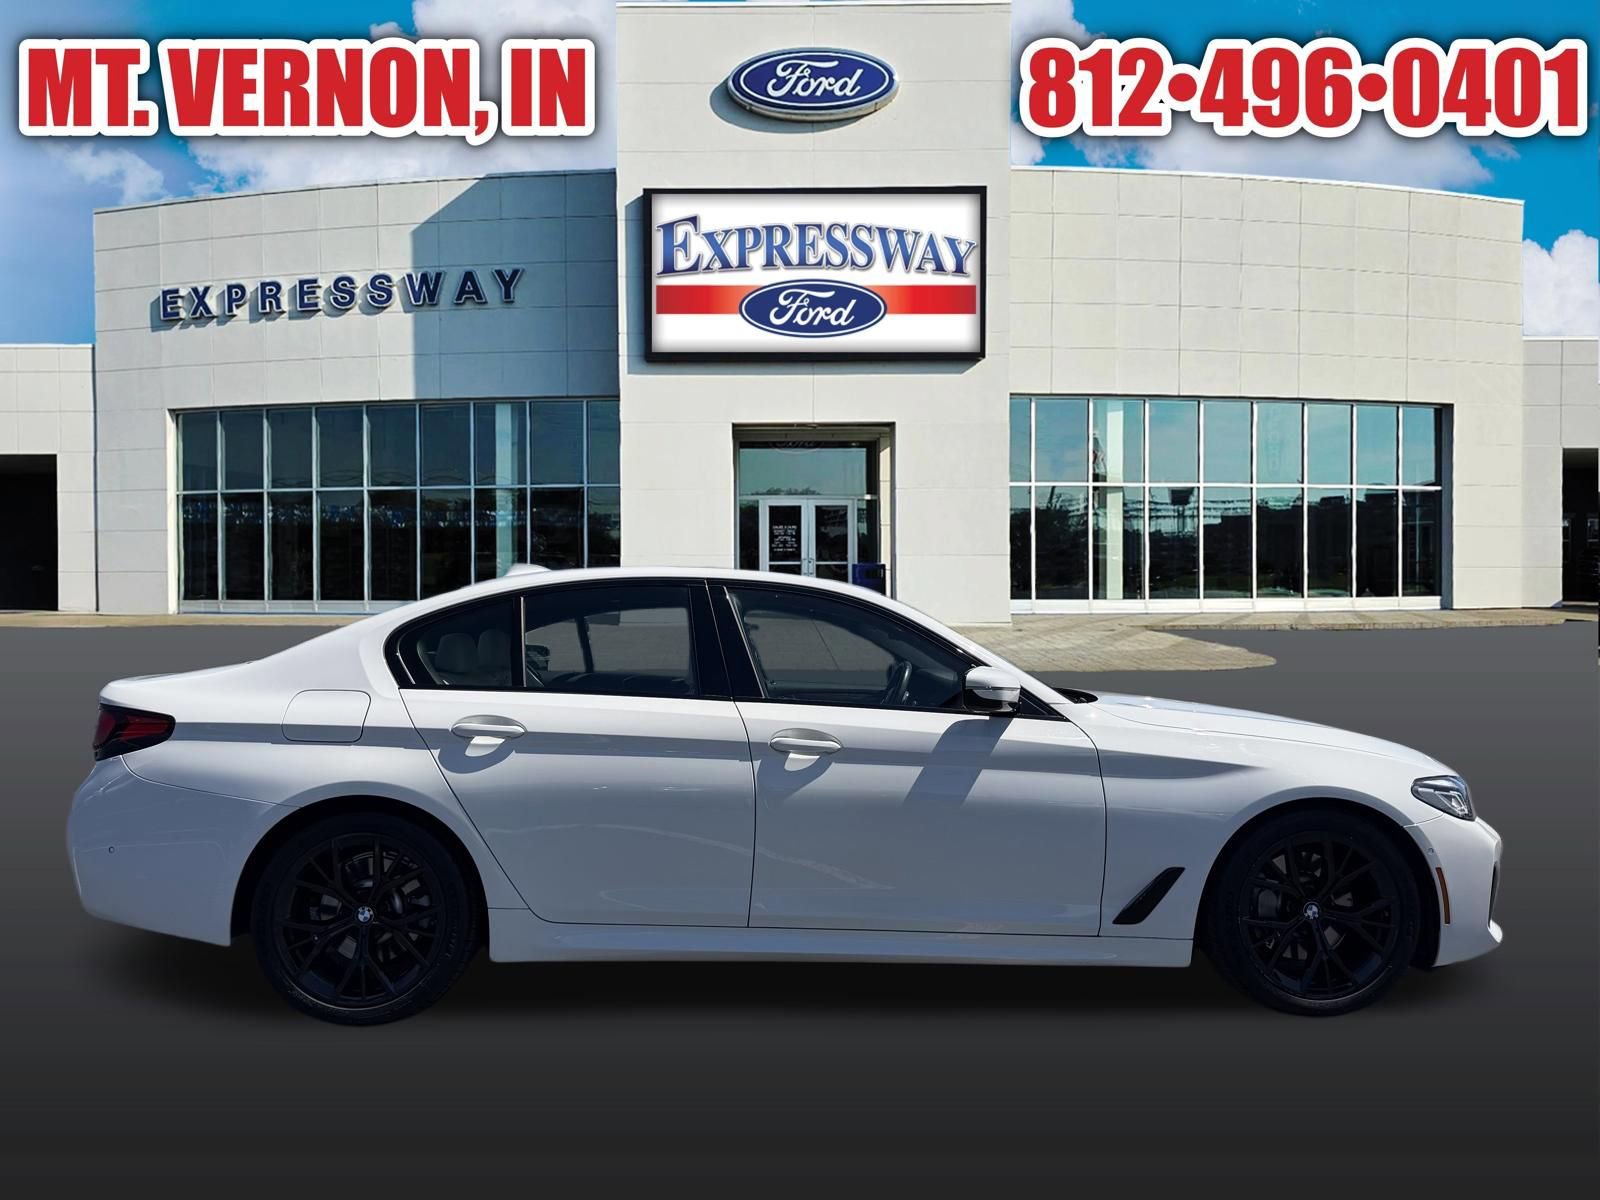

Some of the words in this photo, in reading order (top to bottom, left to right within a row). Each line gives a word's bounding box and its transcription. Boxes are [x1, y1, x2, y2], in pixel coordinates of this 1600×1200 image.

[766, 59, 864, 97] Ford
[160, 268, 526, 321] EXPRESSWAY
[769, 288, 857, 326] Ford
